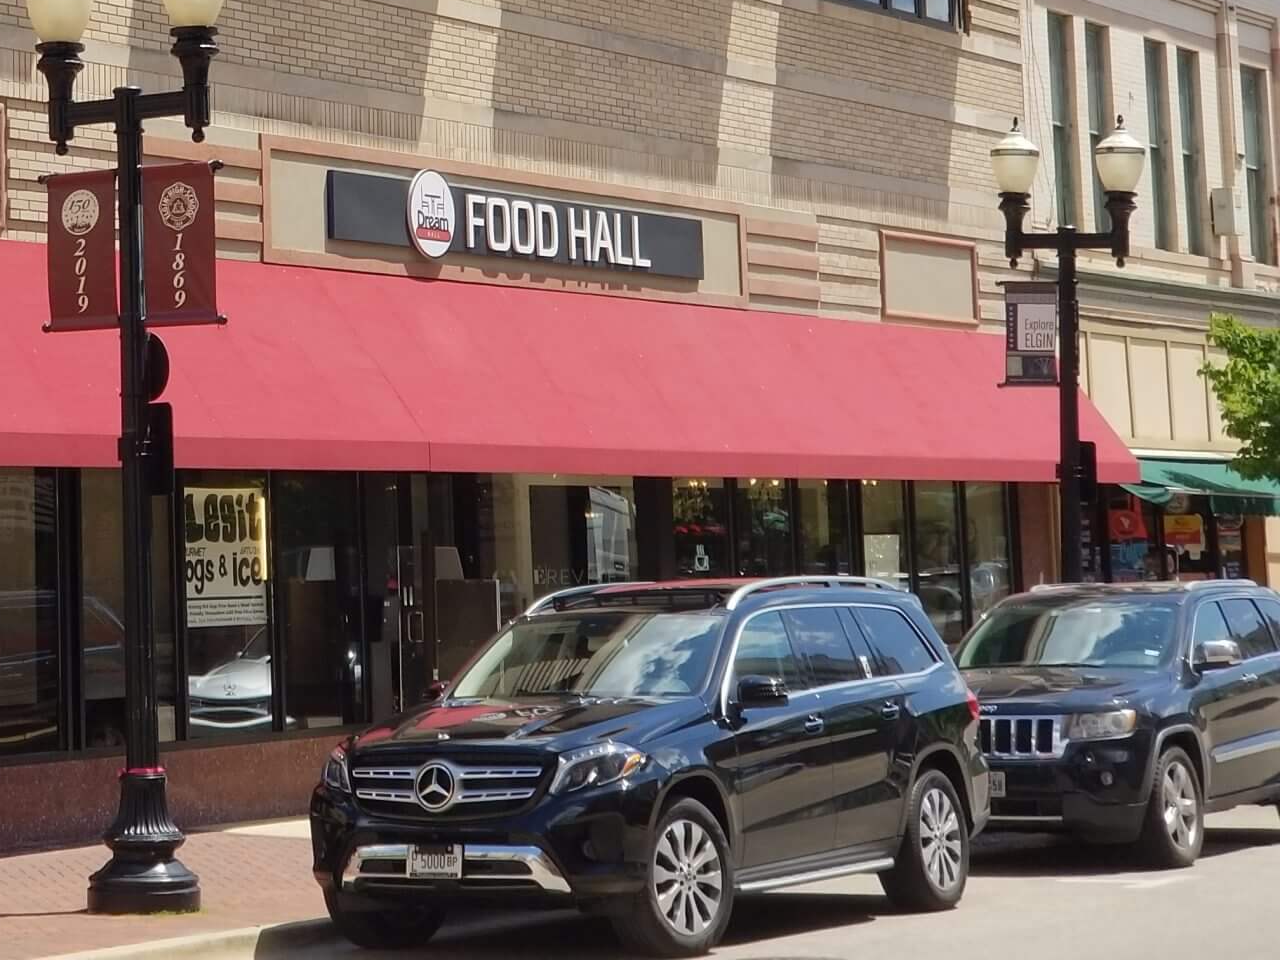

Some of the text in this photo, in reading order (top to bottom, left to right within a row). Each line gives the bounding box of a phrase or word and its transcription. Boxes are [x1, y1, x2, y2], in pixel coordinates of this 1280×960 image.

[69, 199, 90, 214] 150
[418, 209, 449, 232] Dream
[465, 193, 652, 268] FOOD HALL
[73, 238, 89, 313] 2019
[172, 233, 186, 308] 1869
[1024, 319, 1054, 332] Explore
[1025, 333, 1053, 349] ELGIN
[185, 493, 263, 543] Legit
[186, 557, 214, 594] ogs
[219, 554, 228, 578] &
[979, 705, 998, 713] eep
